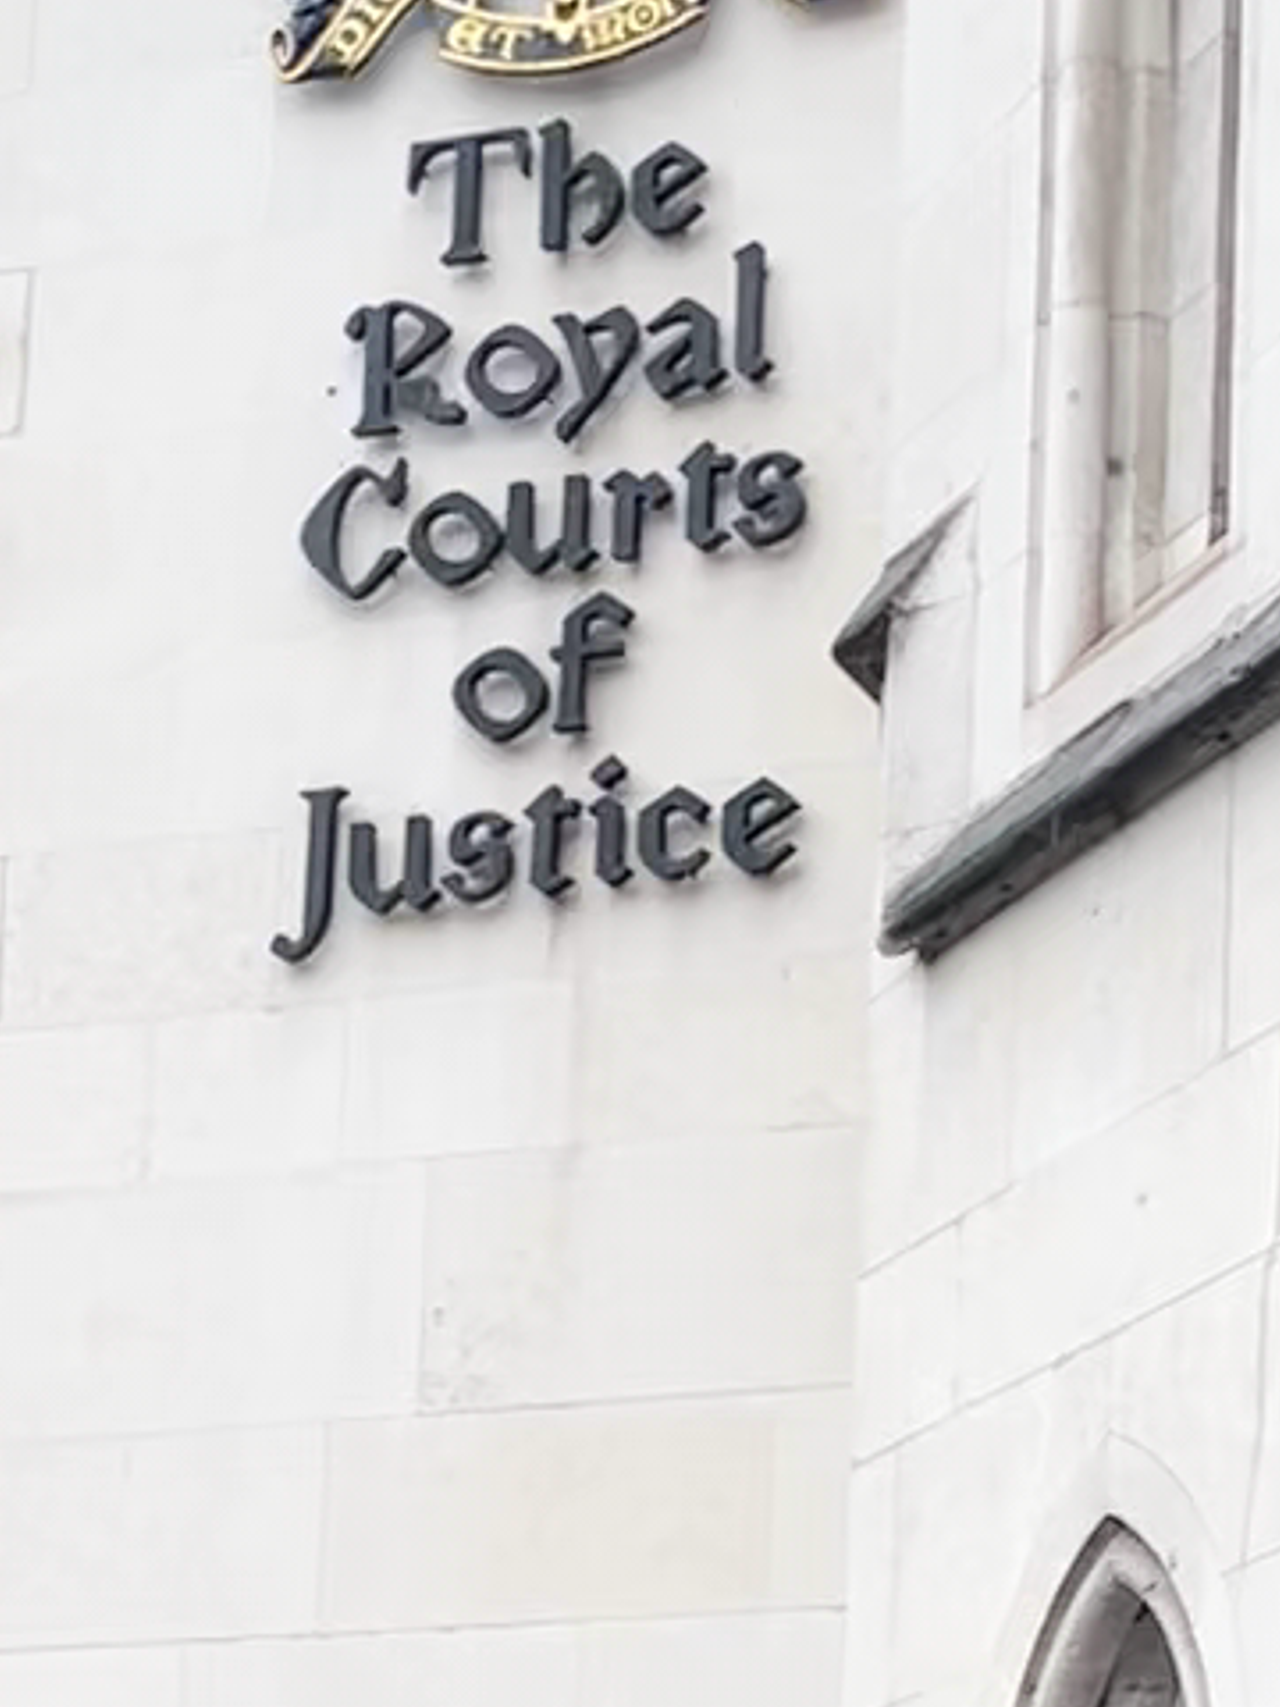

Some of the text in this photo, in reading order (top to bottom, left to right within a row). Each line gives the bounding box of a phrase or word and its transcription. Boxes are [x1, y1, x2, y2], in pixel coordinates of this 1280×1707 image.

[446, 15, 533, 60] ET
[408, 118, 708, 266] The
[346, 243, 775, 444] Royal
[301, 442, 808, 602] Courts
[453, 592, 635, 746] of
[271, 756, 802, 965] Justice
